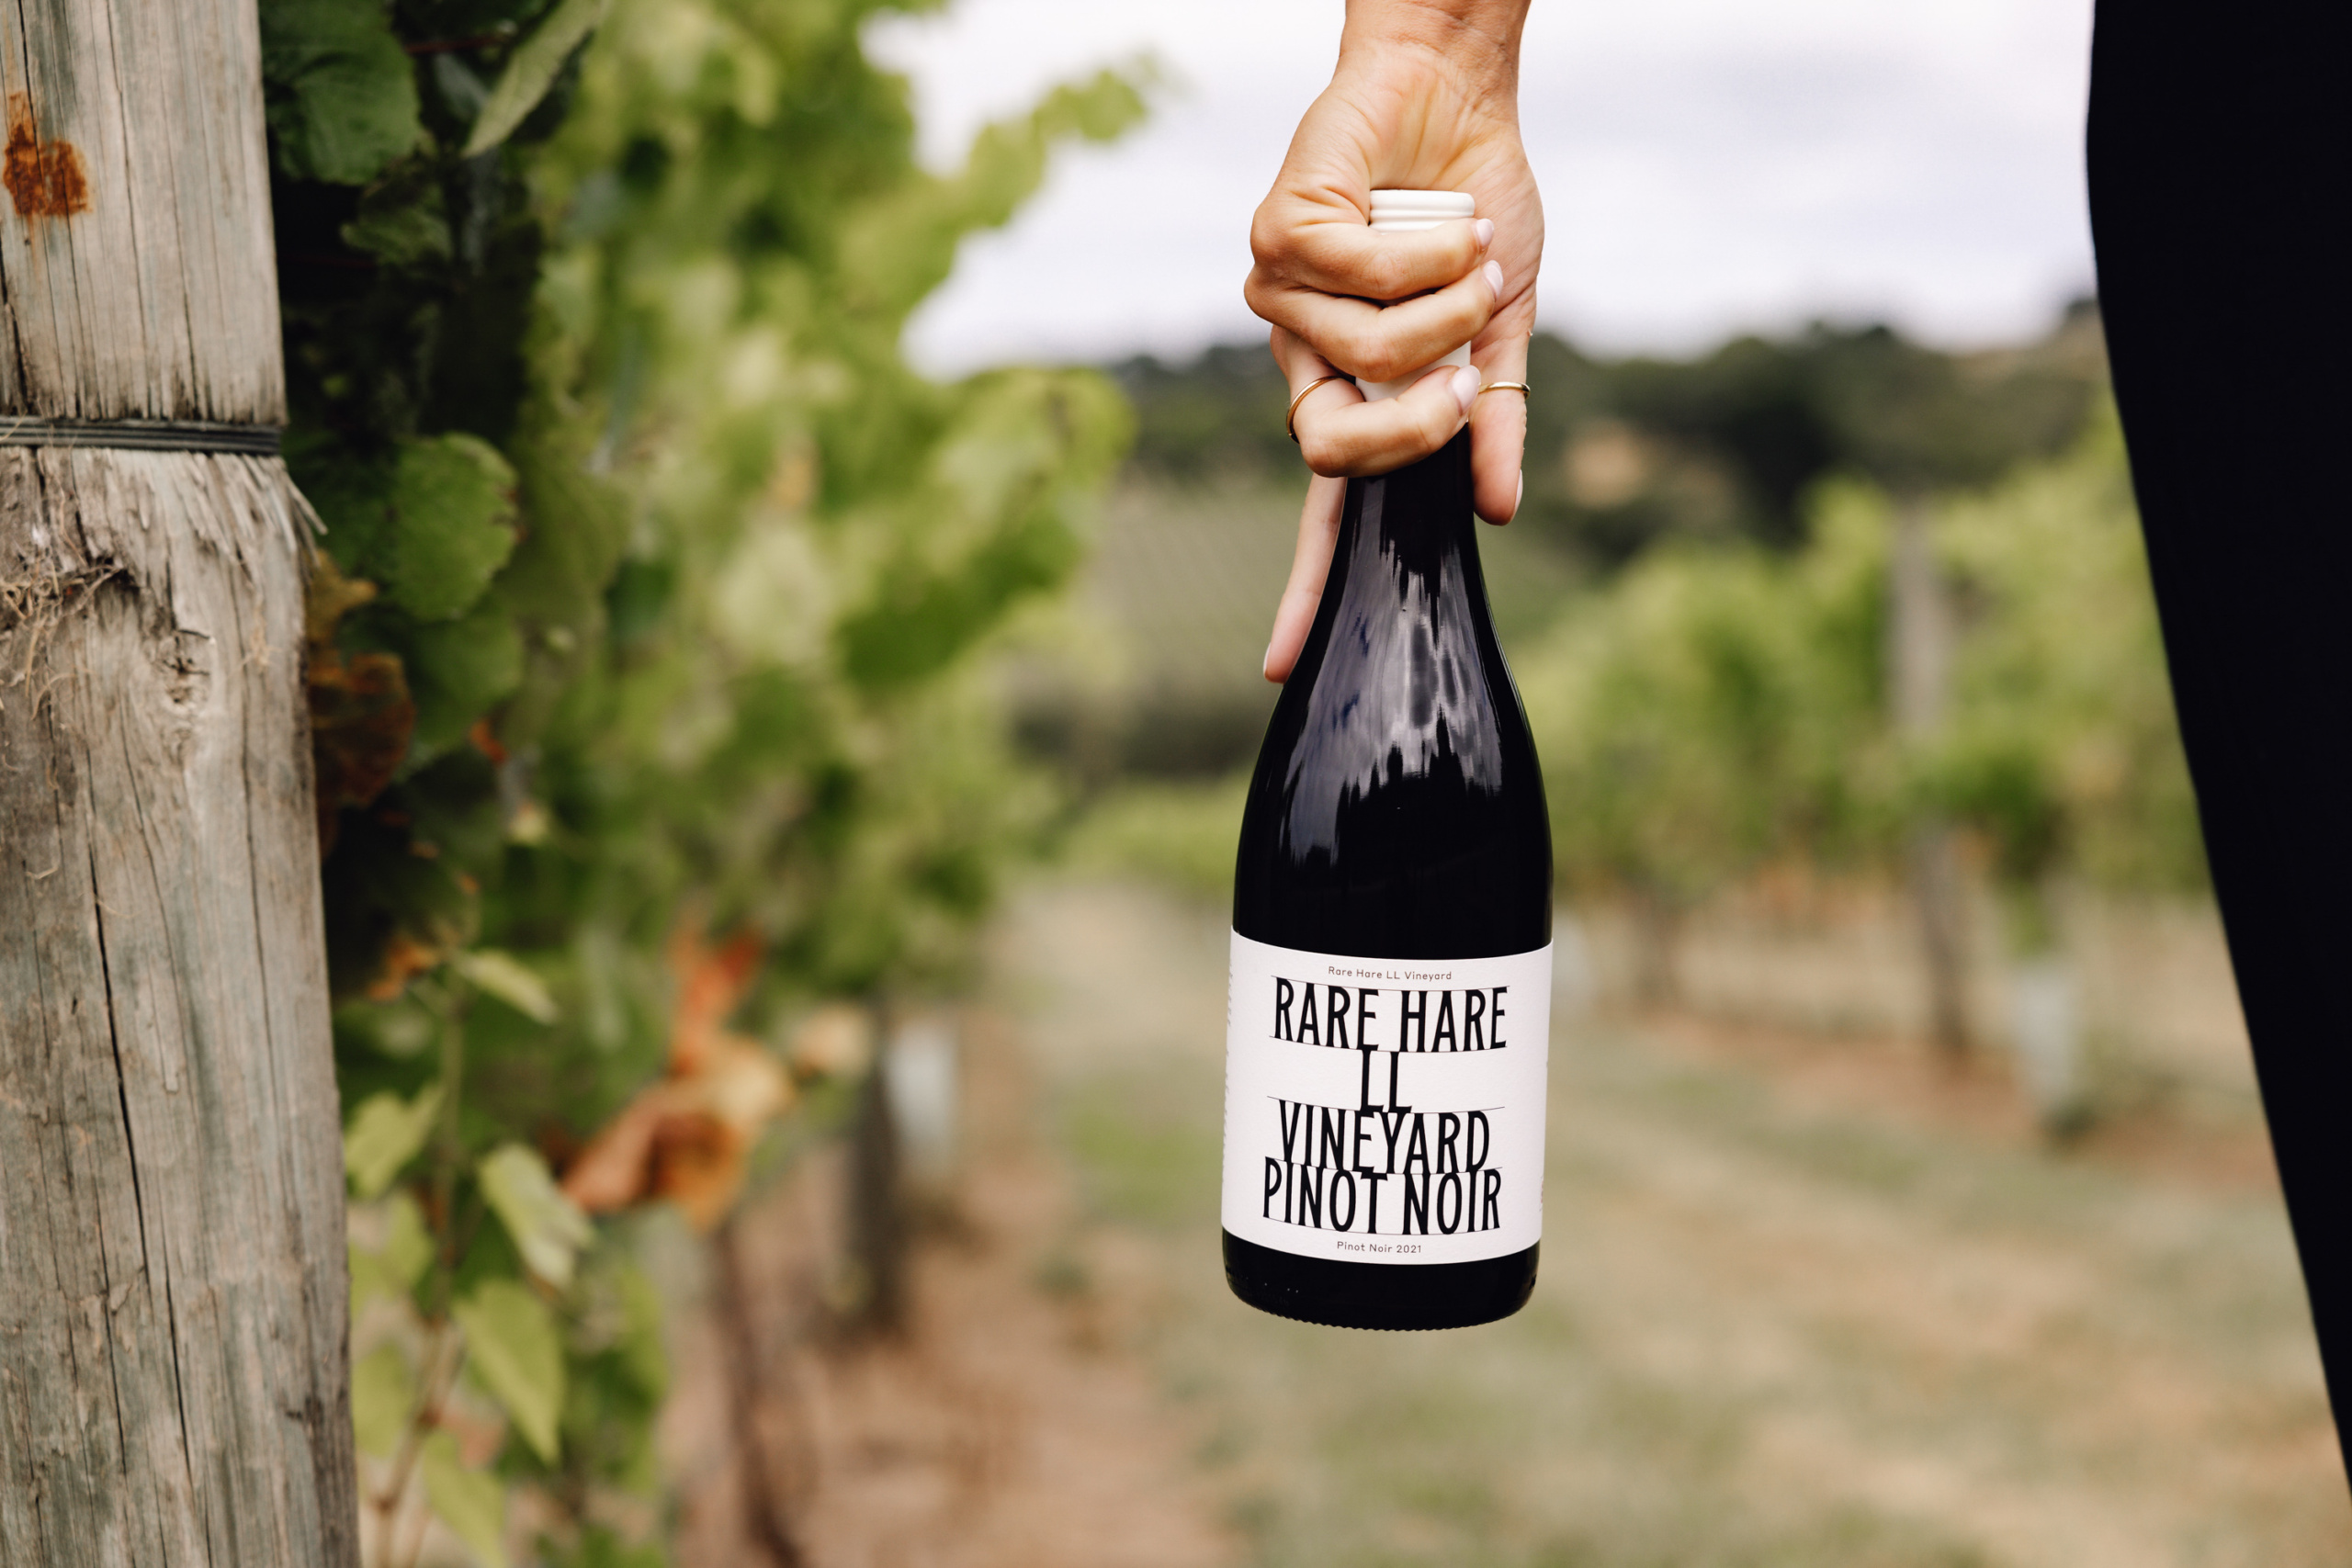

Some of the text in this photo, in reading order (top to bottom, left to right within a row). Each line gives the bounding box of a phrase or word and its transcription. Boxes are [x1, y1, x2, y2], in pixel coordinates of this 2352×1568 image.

[1329, 966, 1452, 982] Rare Hare LL Vineyard
[1274, 976, 1379, 1050] RARE
[1400, 987, 1508, 1053] HARE
[1361, 1049, 1412, 1112] LL
[1279, 1100, 1489, 1174] VINEYARD
[1262, 1156, 1387, 1234] PINOT
[1402, 1168, 1501, 1235] NOIR
[1337, 1241, 1422, 1254] Pinot Noir 2021
